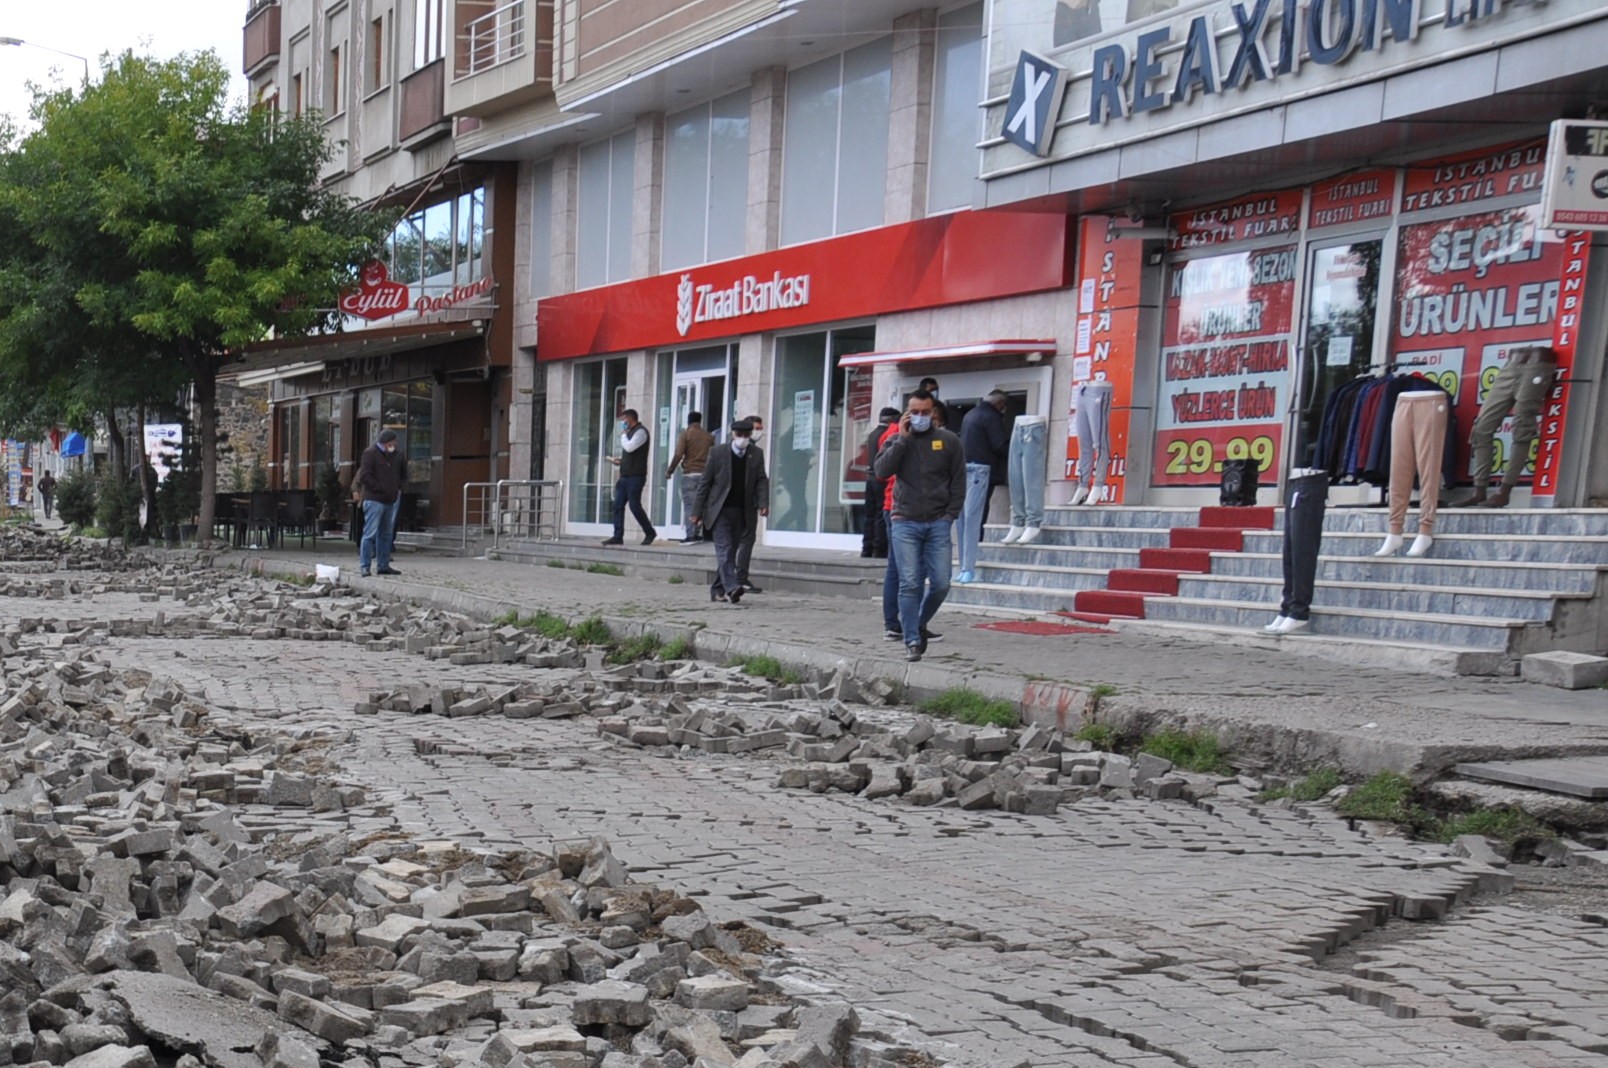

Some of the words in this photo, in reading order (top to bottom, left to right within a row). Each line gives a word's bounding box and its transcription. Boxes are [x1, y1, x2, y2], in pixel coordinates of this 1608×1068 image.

[1434, 147, 1544, 184] İSTANBU
[1405, 177, 1495, 210] TEKSTİL
[343, 287, 403, 313] Eylül
[414, 276, 492, 318] Pastane
[694, 280, 742, 323] Ziraat
[742, 271, 810, 315] Bankası
[1238, 380, 1277, 420] ÜRÜN
